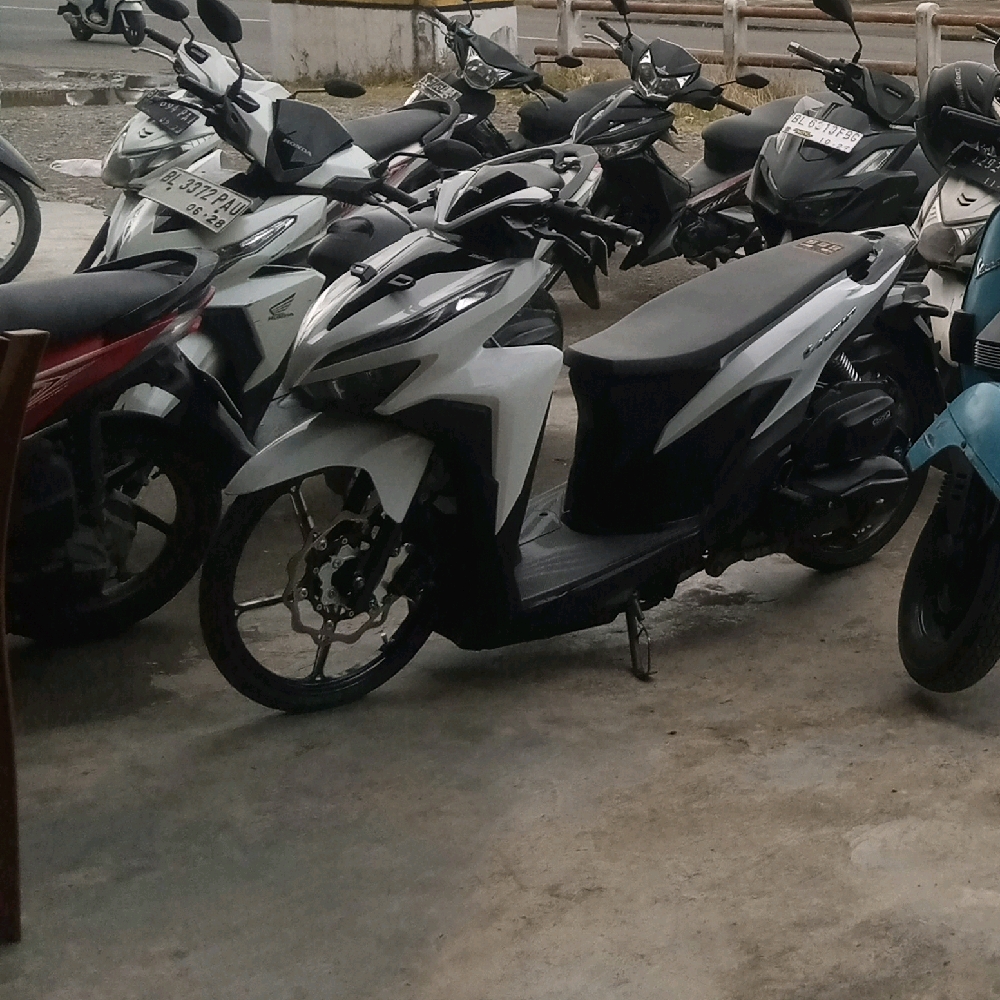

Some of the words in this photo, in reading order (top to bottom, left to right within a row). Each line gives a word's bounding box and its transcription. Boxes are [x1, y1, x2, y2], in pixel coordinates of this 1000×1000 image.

[160, 170, 182, 187] BL
[179, 178, 218, 201] 3372
[211, 192, 247, 216] PAU
